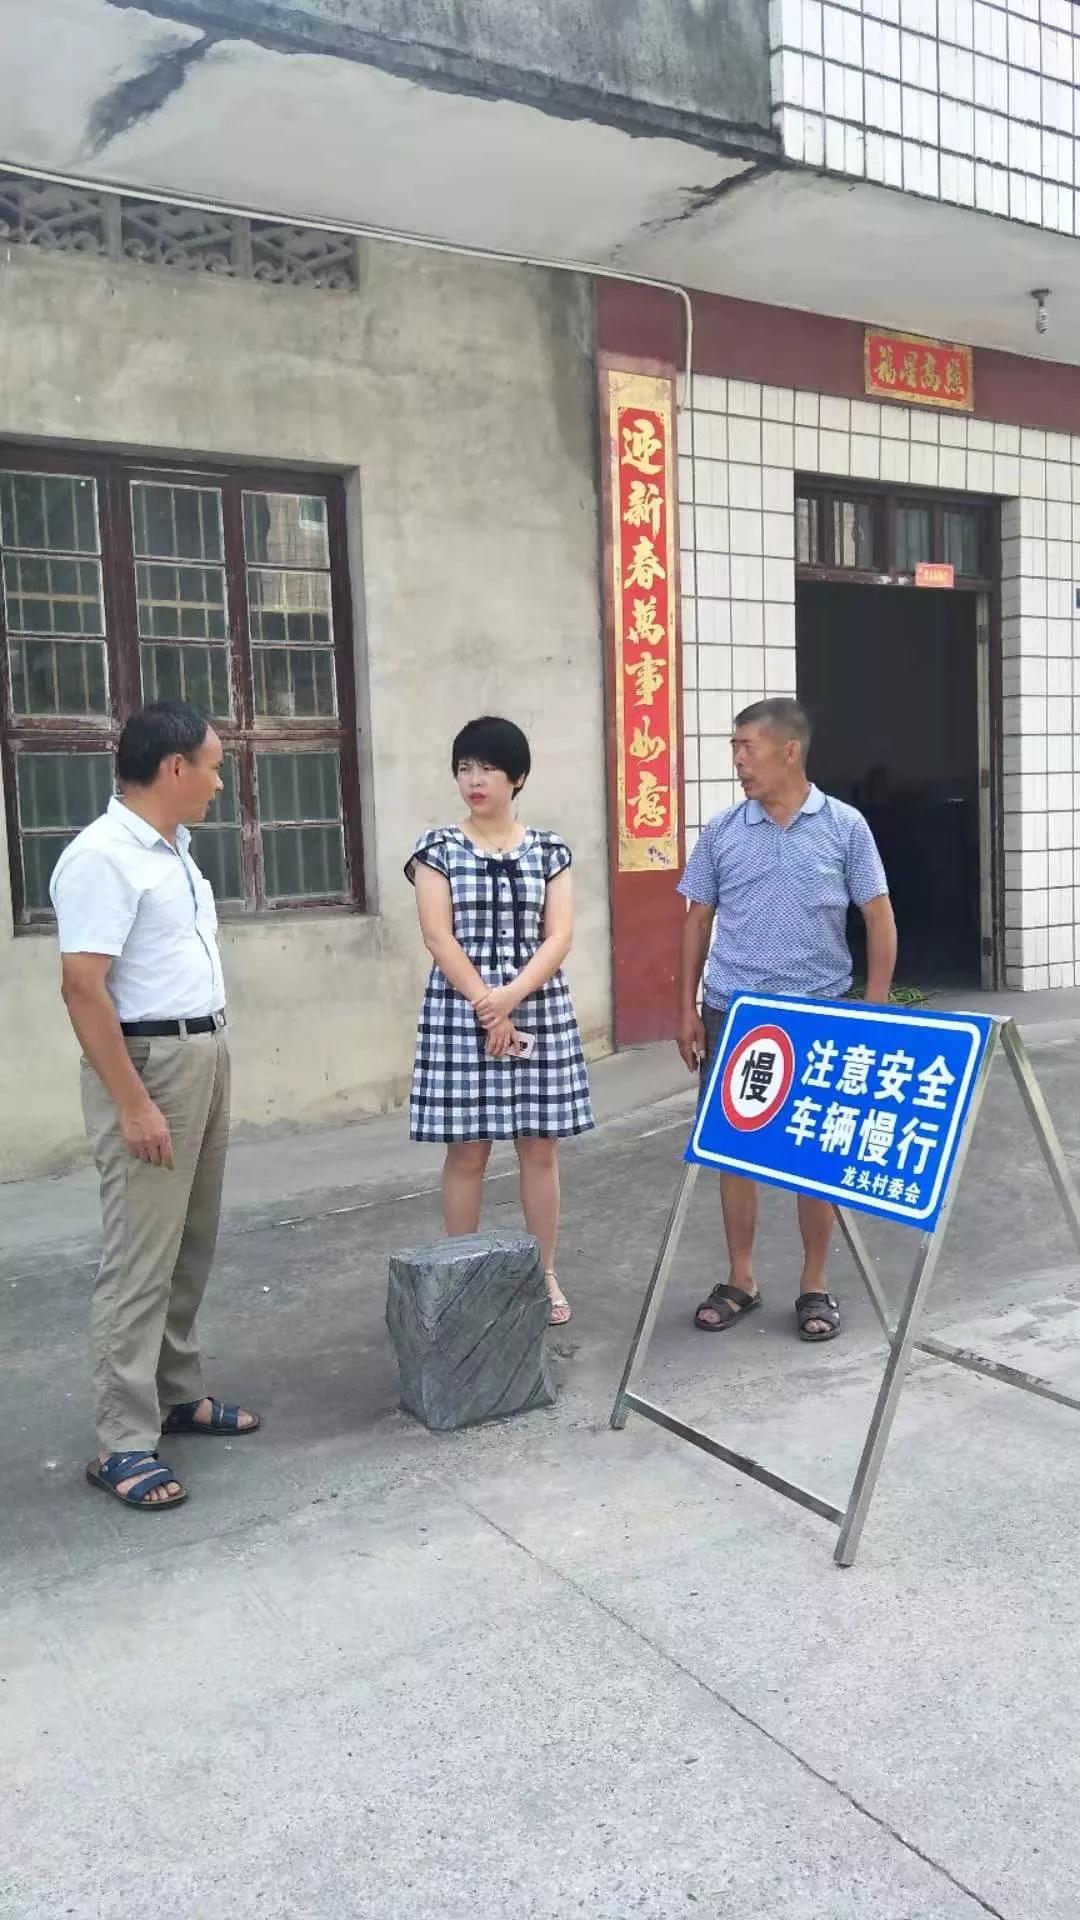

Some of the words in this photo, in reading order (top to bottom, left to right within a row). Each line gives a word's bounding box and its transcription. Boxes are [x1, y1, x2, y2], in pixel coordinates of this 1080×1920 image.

[739, 1049, 776, 1104] 慢
[800, 1039, 957, 1111] 注意安全
[784, 1096, 941, 1175] 车辆慢行
[840, 1165, 922, 1205] 龙头村委会
